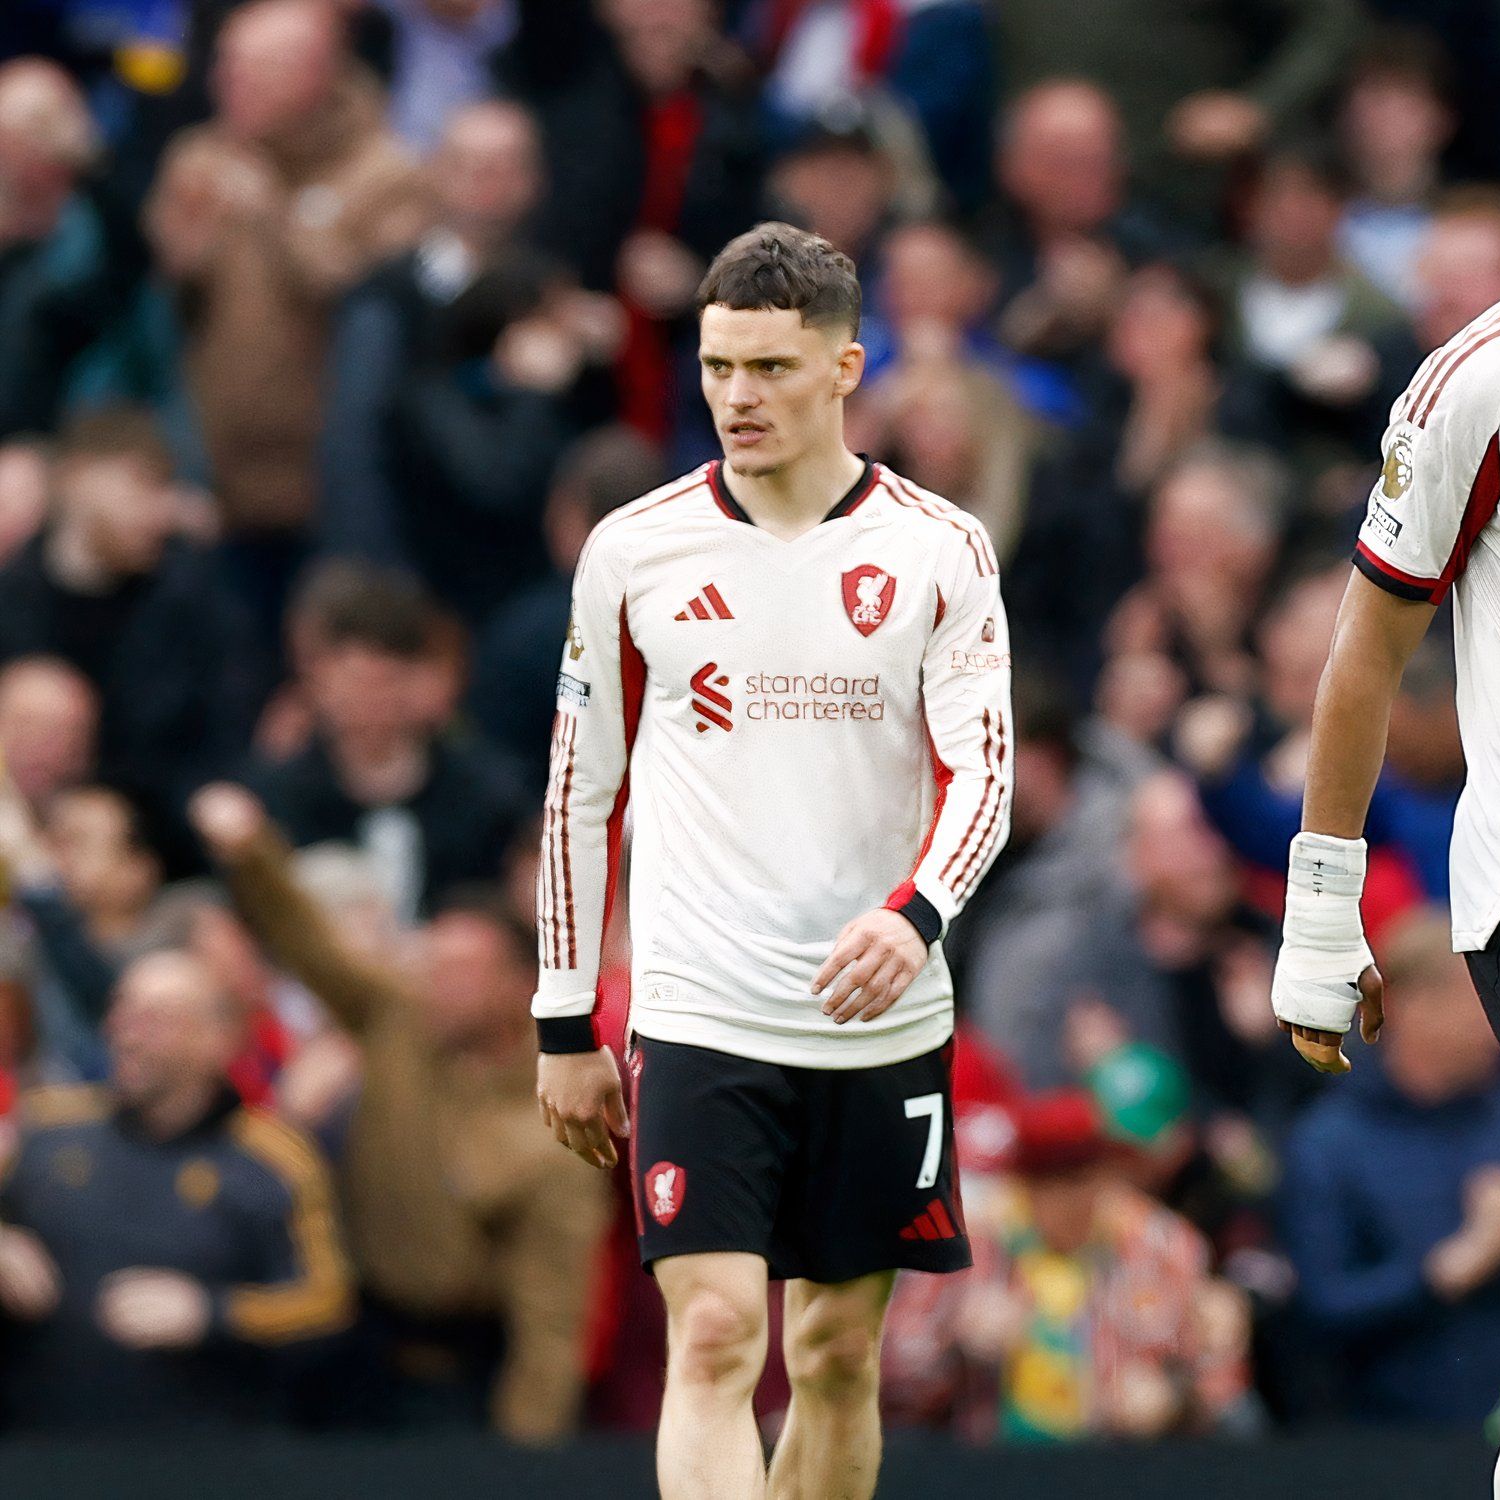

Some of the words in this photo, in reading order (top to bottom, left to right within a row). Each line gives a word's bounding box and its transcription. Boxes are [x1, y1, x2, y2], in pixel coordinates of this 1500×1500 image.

[746, 671, 879, 695] standard
[747, 699, 884, 720] chartered
[904, 1093, 943, 1189] 7
